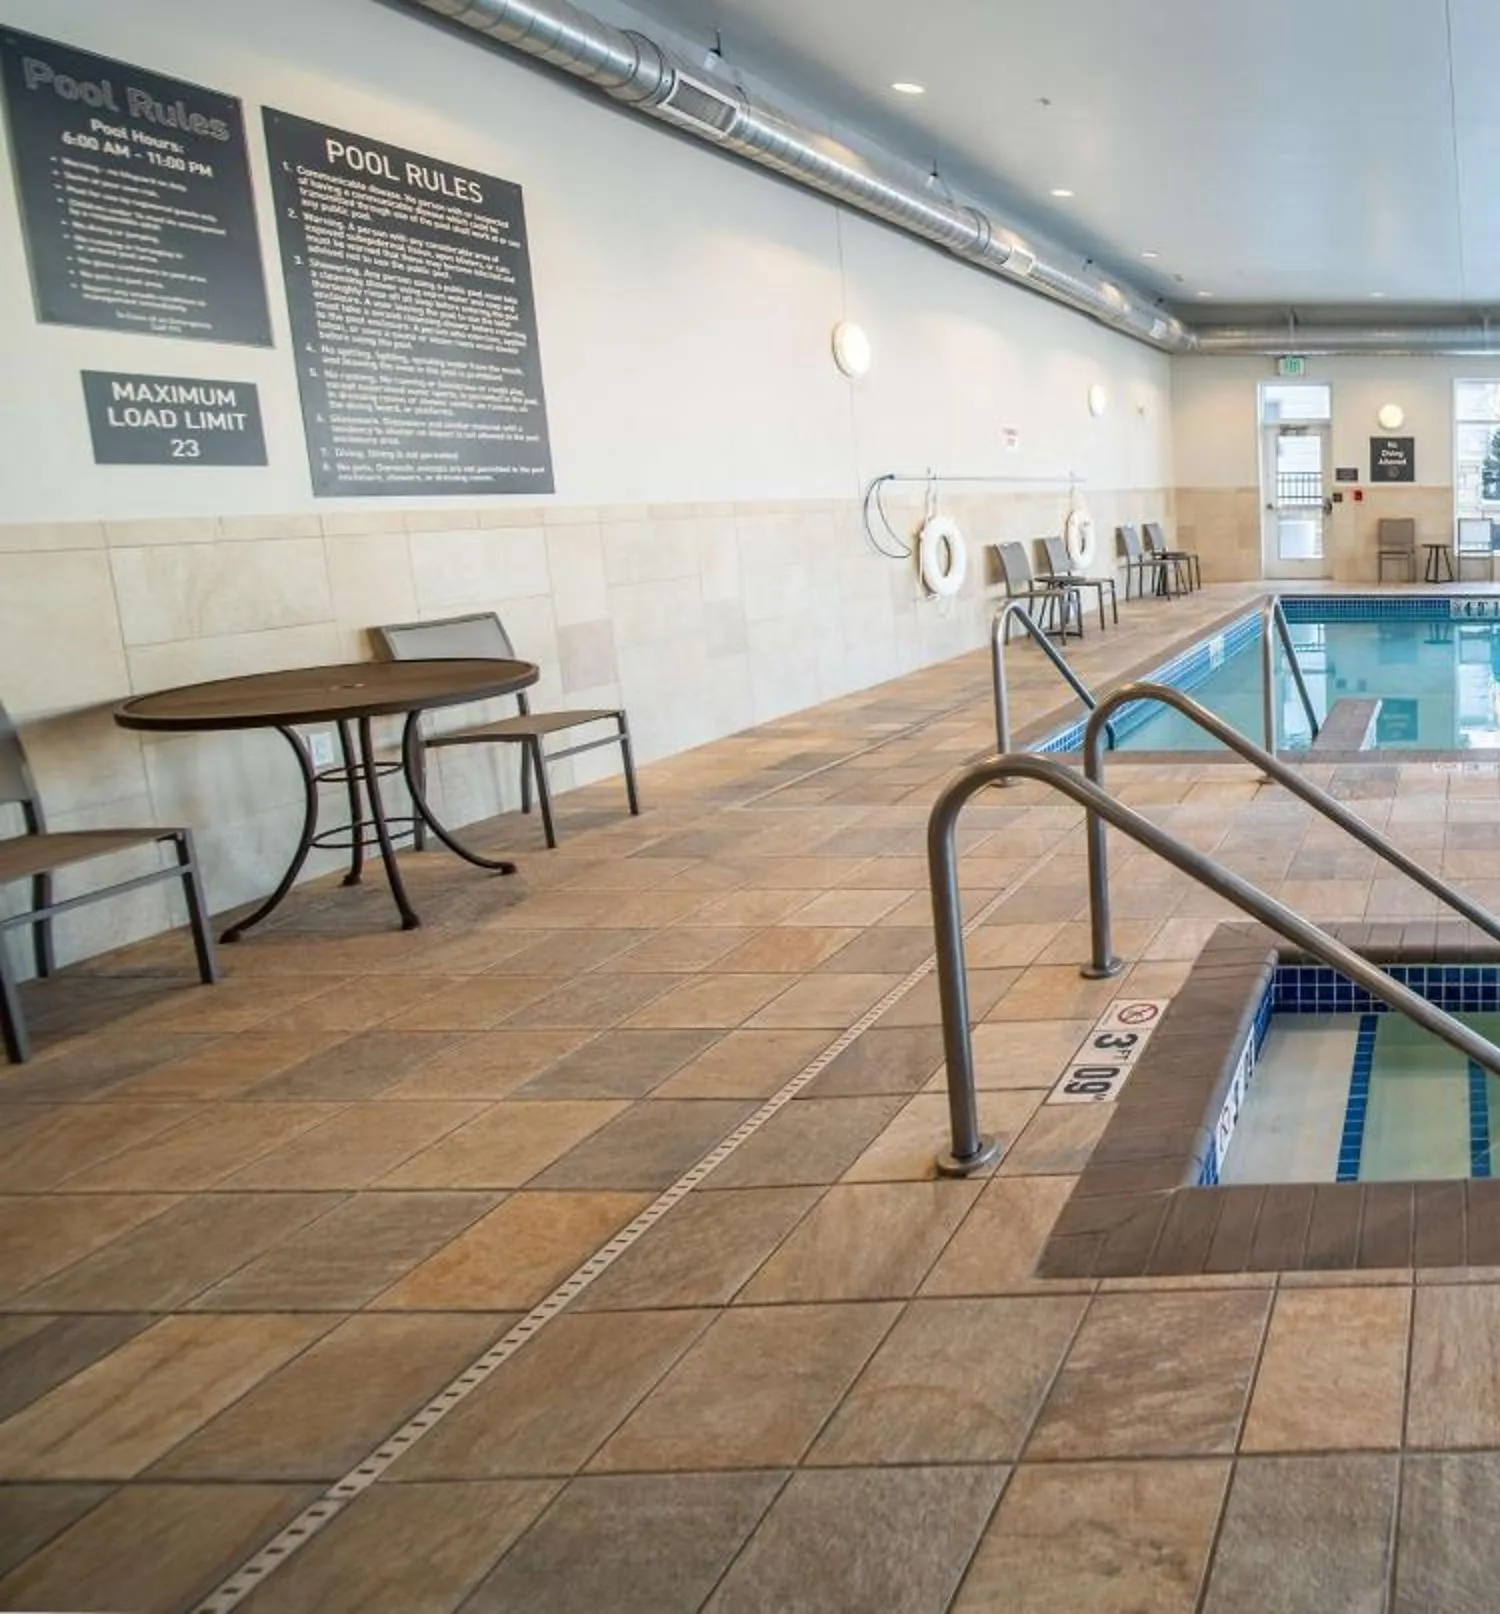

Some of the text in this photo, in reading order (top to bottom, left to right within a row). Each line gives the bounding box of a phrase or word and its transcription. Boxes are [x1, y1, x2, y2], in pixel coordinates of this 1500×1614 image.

[22, 56, 230, 142] Pool Rules
[90, 118, 186, 154] Pool Hours:
[62, 131, 100, 151] 6:00
[102, 140, 129, 160] AM
[147, 150, 186, 172] 11:00
[188, 160, 214, 178] PM
[325, 138, 483, 203] POOL RULES
[111, 381, 237, 407] MAXIMUM
[107, 407, 247, 431] LOAD LIMIT
[170, 439, 200, 457] 23
[1094, 1033, 1138, 1049] 3
